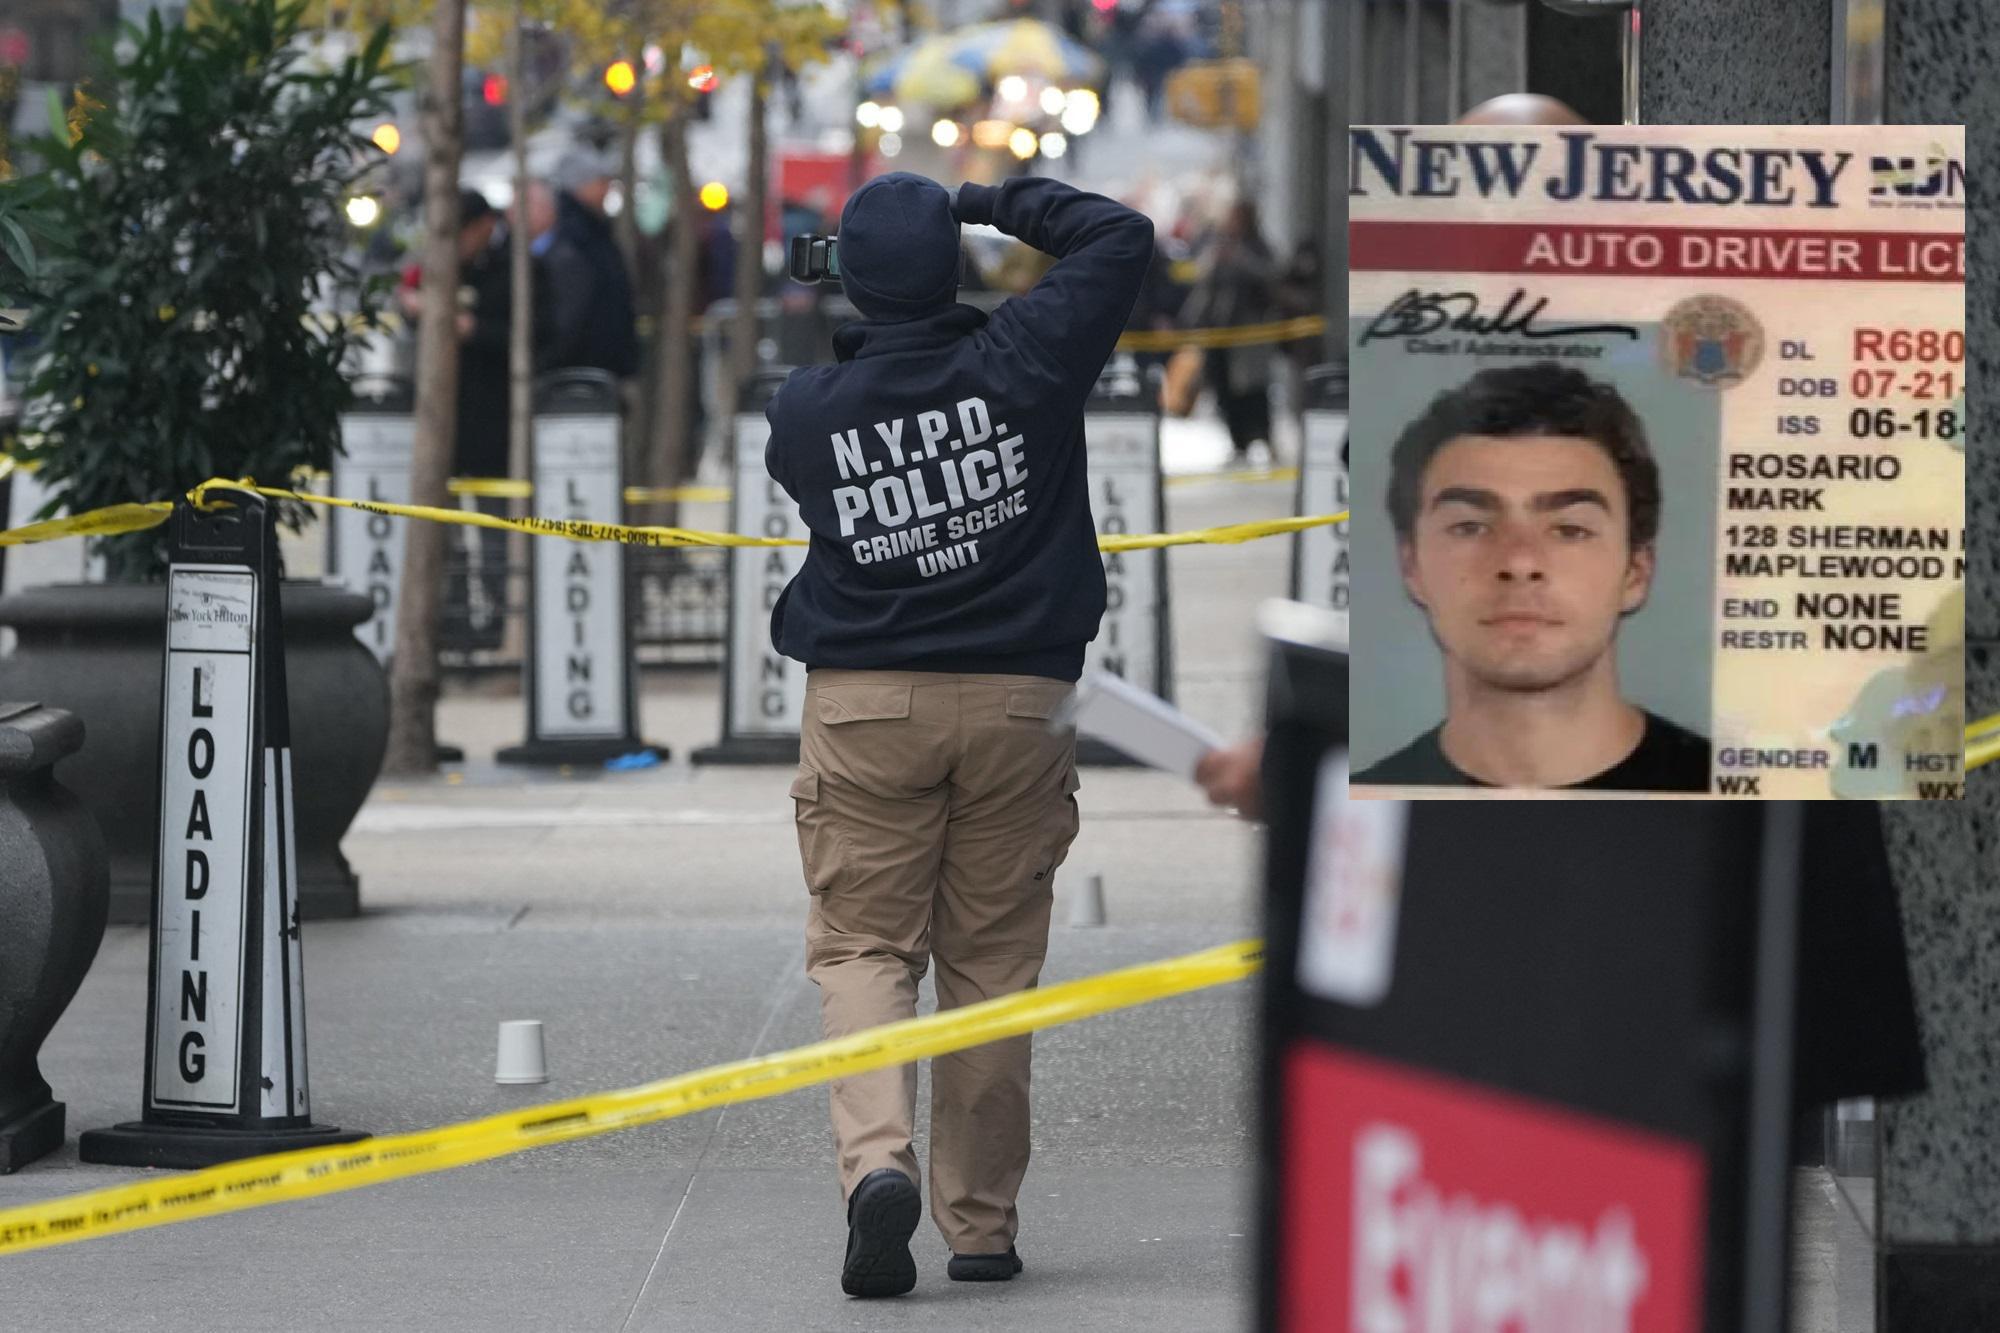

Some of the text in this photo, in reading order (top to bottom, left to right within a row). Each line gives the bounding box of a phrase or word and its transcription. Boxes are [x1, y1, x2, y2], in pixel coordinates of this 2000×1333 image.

[1545, 131, 1853, 208] JERSEY
[1525, 231, 1662, 268] AUTO
[1679, 235, 1861, 273] DRIVER
[1780, 328, 1965, 363] DL R680
[1778, 377, 1838, 397] DOB
[830, 396, 1008, 480] N.Y.P.D.
[1777, 415, 1821, 435] ISS
[1729, 453, 1901, 481] ROSARIO
[832, 433, 1029, 537] POLICE
[1726, 487, 1826, 511] MARK
[852, 489, 1028, 565] CRIME SCENE
[1726, 525, 1778, 548] 128
[1787, 526, 1949, 550] SHERMAN
[916, 539, 980, 578] UNIT
[1725, 553, 1945, 579] MAPLEWOOD
[566, 477, 593, 719] LADING
[761, 479, 789, 718] LOADNG
[1723, 592, 1901, 620] END NONE
[1721, 623, 1930, 651] RESTR NONE
[1718, 742, 1961, 772] GENDER M HGT
[179, 667, 215, 1083] LOADING
